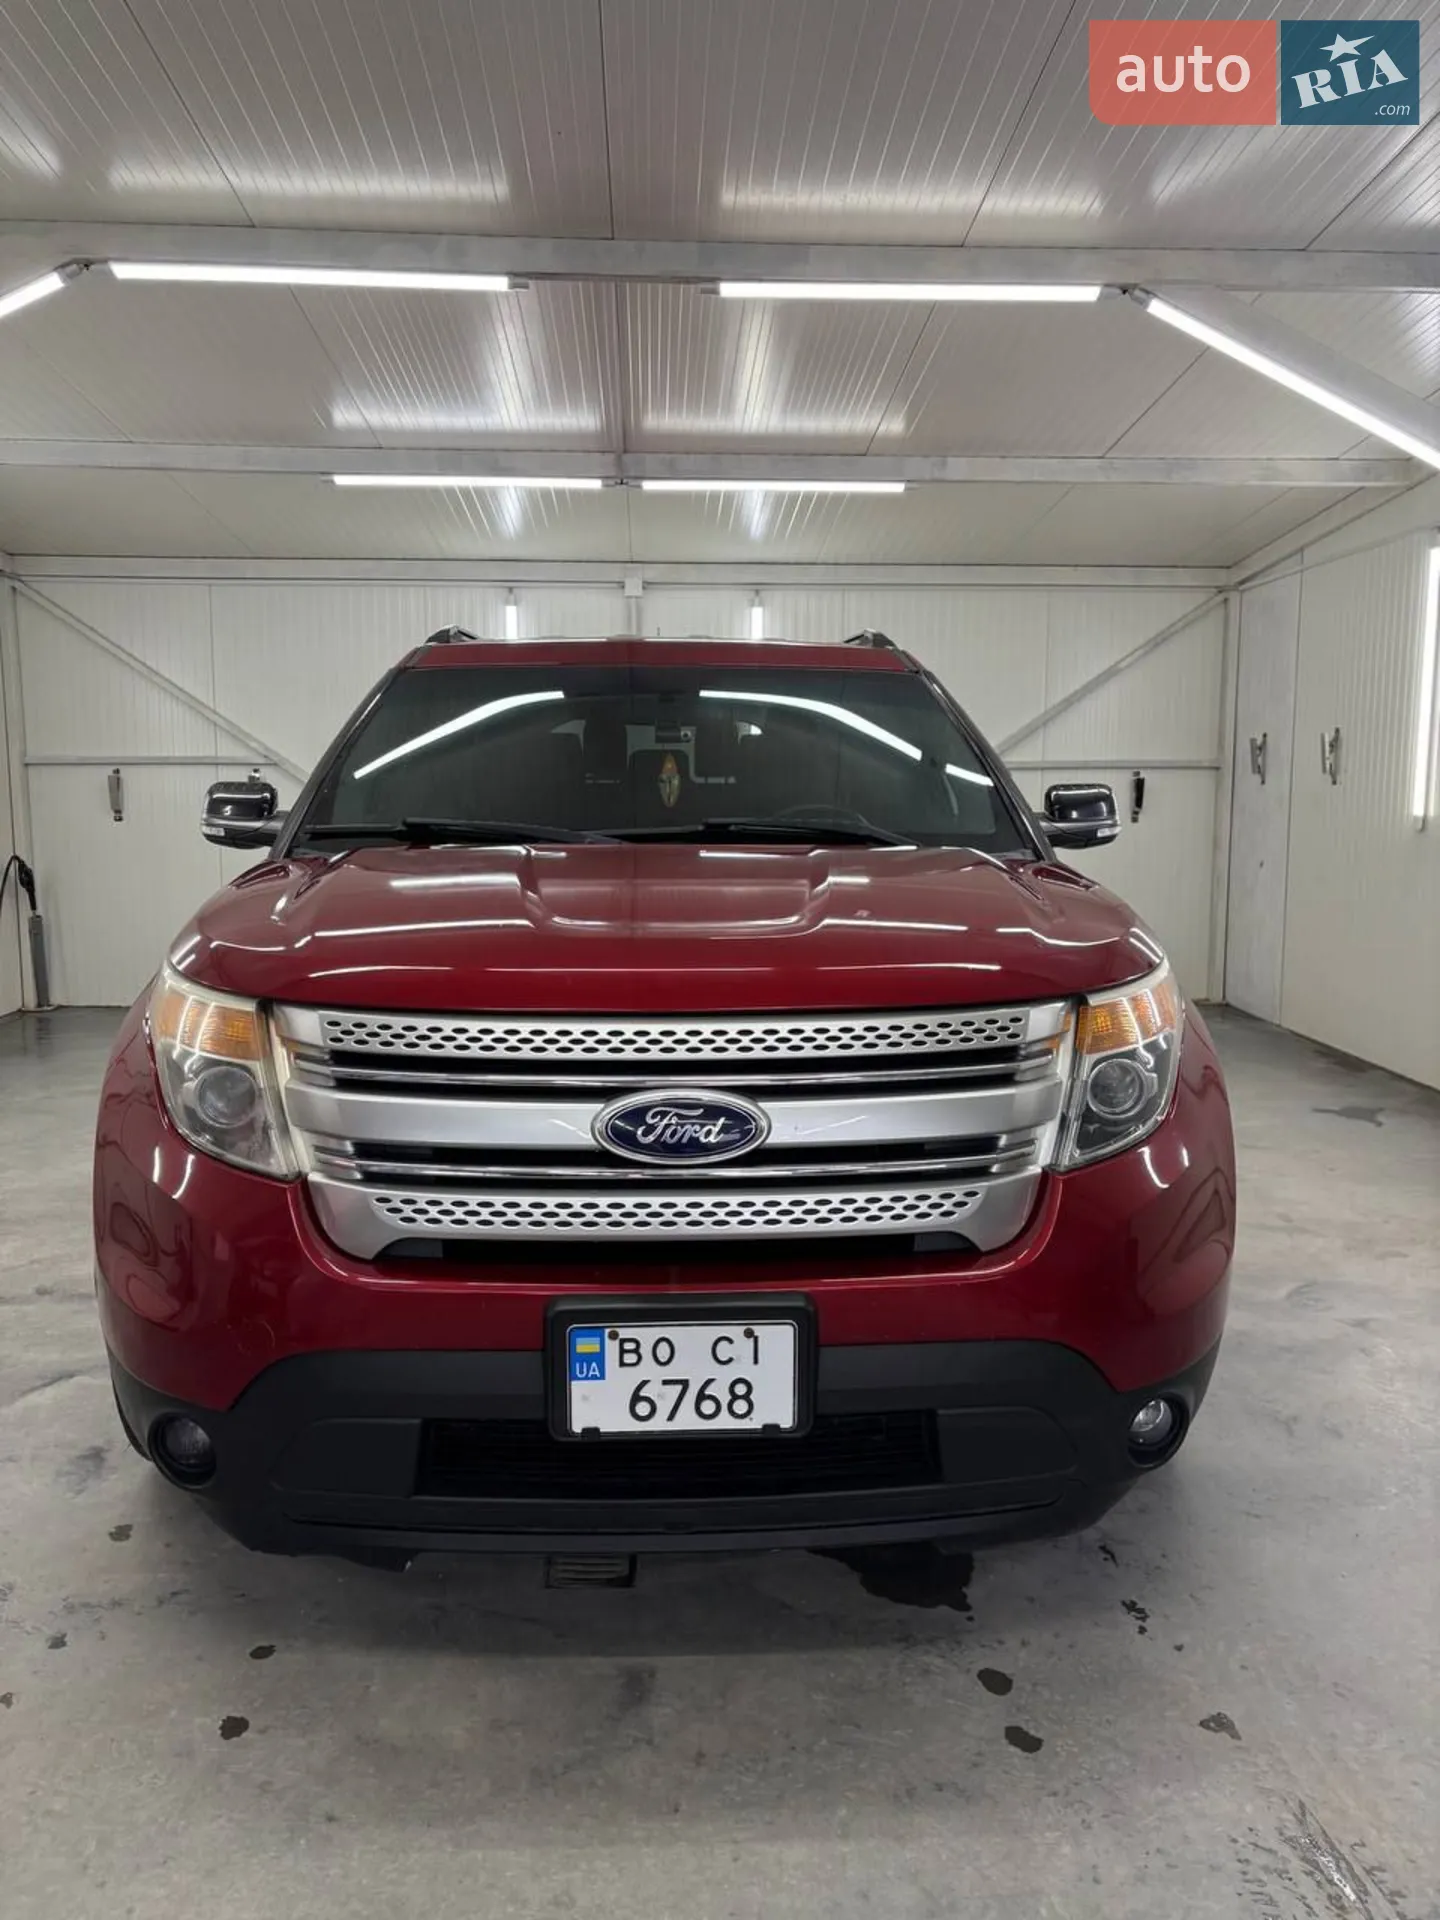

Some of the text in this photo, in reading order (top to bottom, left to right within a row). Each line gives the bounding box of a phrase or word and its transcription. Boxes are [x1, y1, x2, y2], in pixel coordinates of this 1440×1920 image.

[636, 1107, 732, 1144] Ford
[575, 1362, 601, 1378] UA
[628, 1377, 755, 1422] 6768
